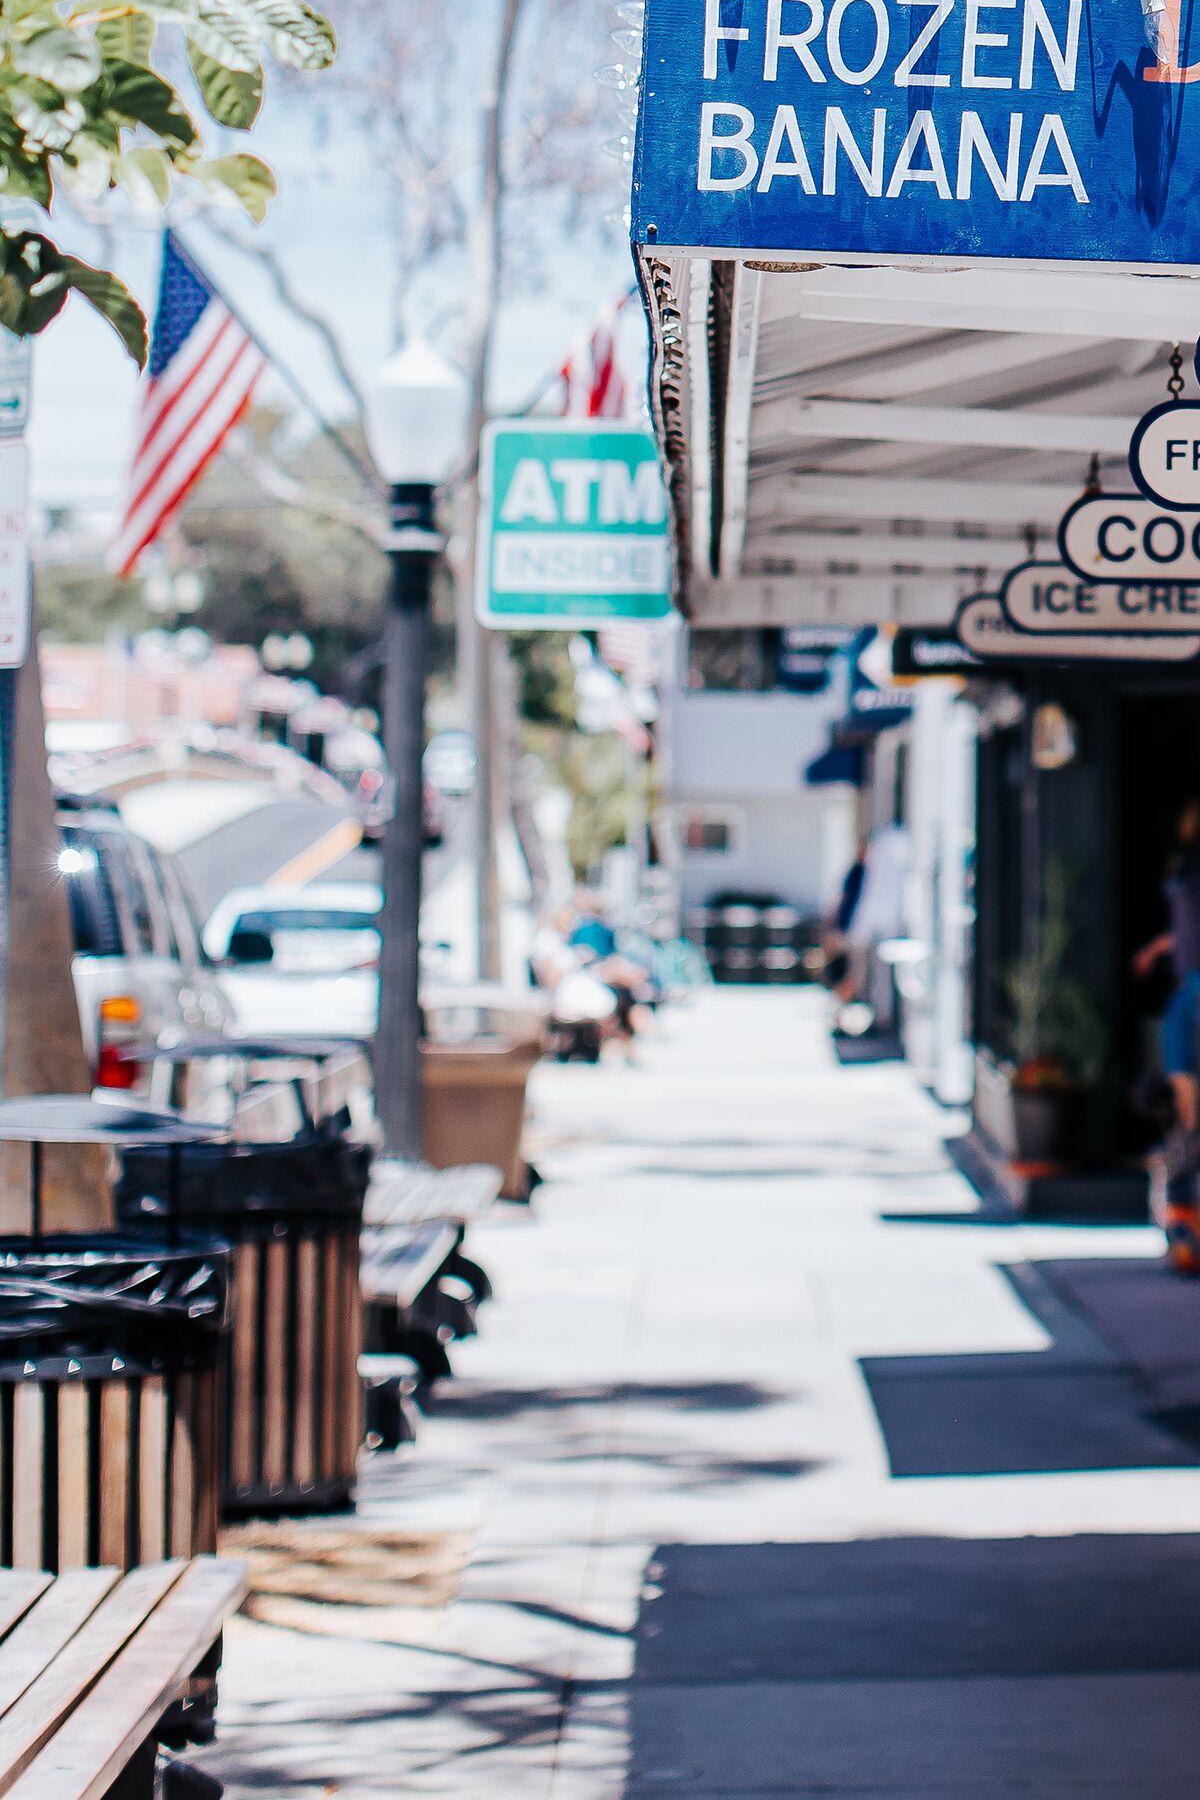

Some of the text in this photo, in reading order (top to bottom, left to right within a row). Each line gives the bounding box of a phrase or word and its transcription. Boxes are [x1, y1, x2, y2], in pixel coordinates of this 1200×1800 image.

[697, 101, 1090, 204] BANANA
[500, 457, 666, 525] ATM
[1032, 583, 1097, 614] ICE
